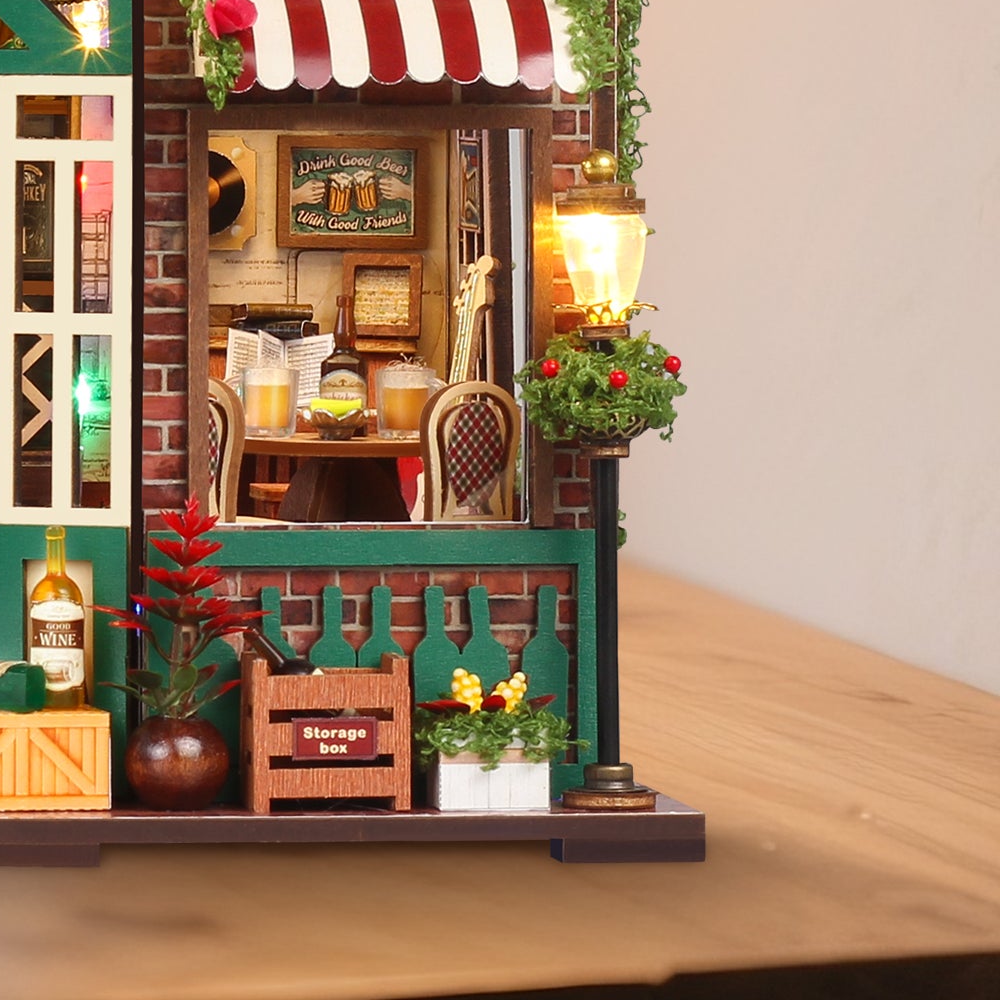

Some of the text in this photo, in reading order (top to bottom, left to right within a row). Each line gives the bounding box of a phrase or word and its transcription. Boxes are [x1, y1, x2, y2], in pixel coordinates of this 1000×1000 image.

[297, 152, 408, 177] Drink Good Beer
[297, 210, 407, 230] With Good Friends
[45, 622, 71, 630] GOOD
[39, 631, 77, 646] WINE
[303, 726, 367, 741] Storage
[319, 742, 348, 754] box
